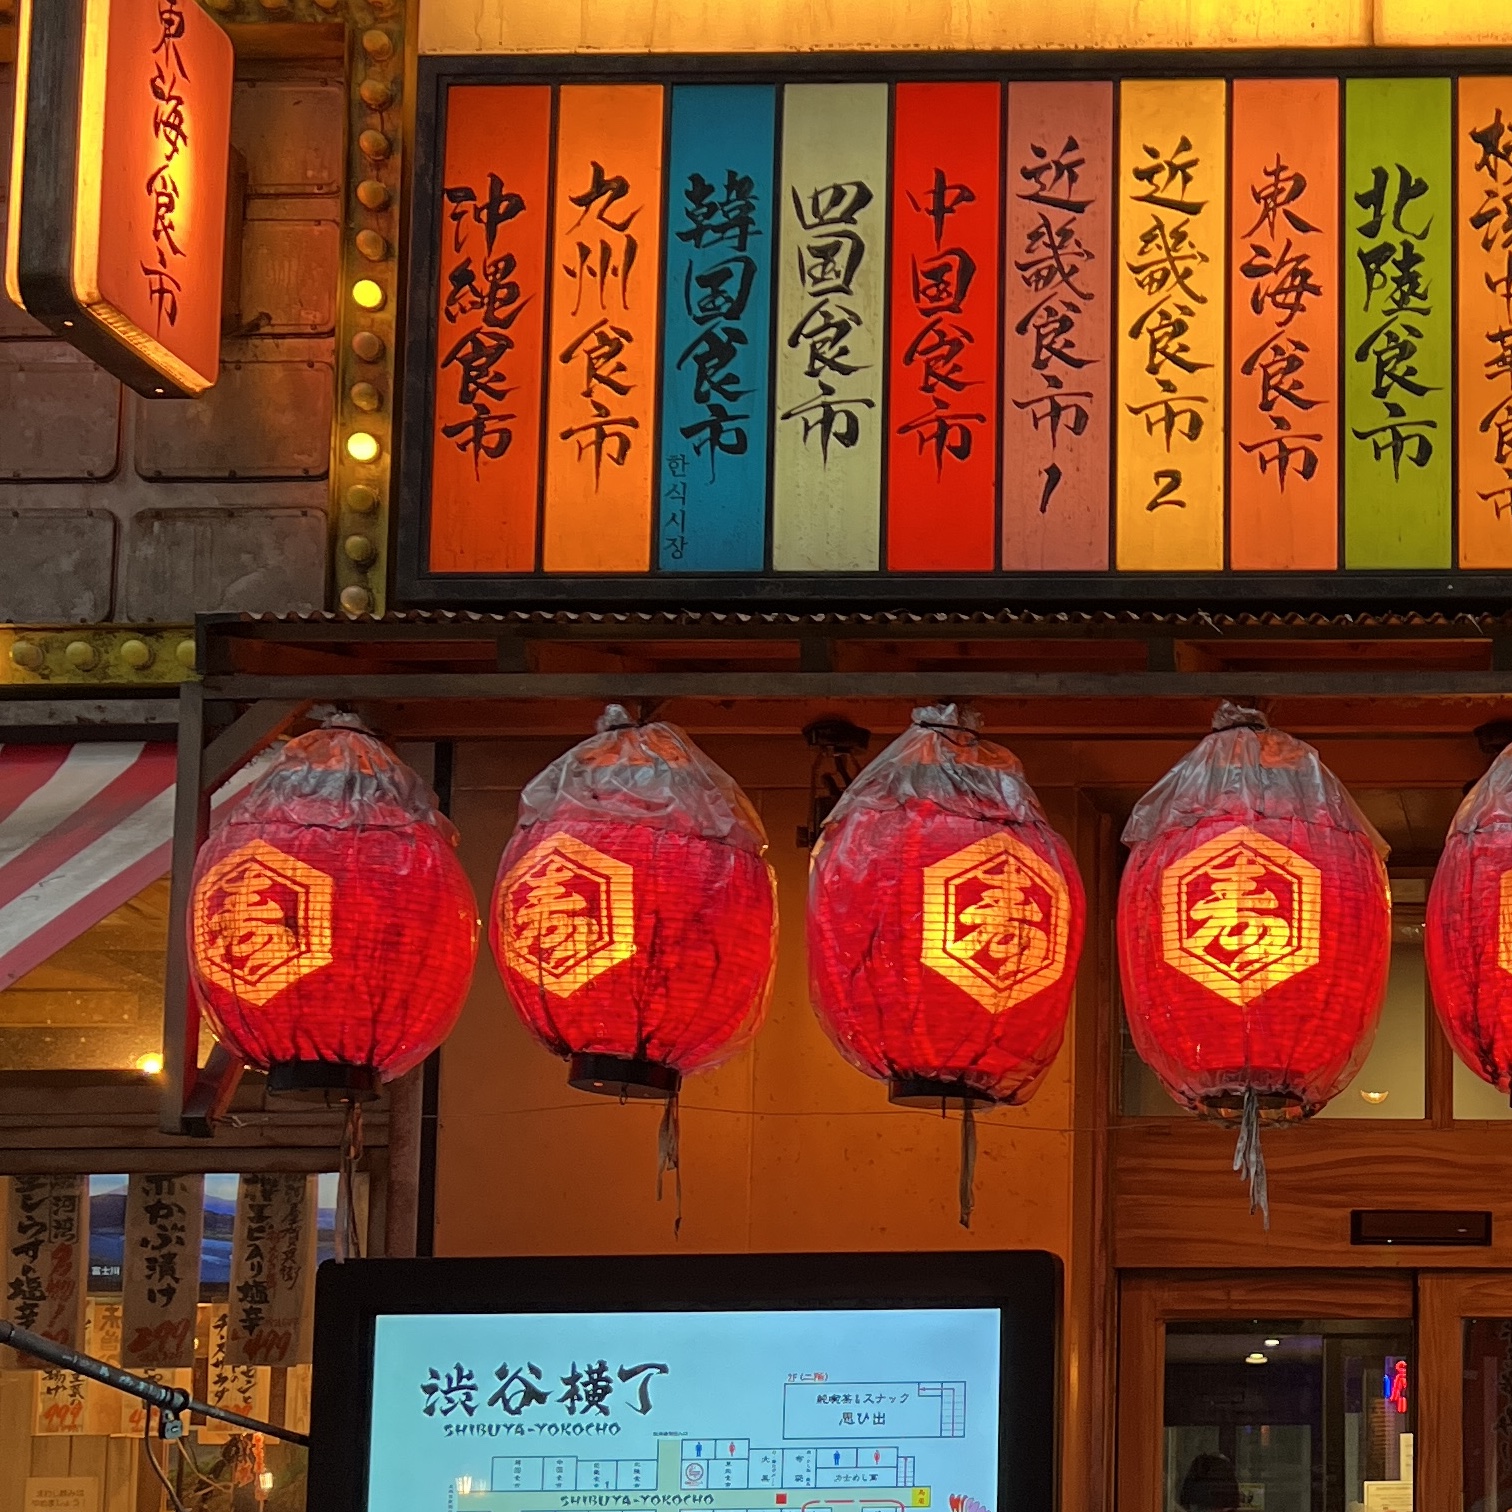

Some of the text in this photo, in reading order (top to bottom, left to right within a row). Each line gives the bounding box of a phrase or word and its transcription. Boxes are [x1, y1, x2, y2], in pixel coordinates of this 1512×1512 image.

[141, 0, 190, 337] 東海食市
[441, 173, 536, 481] 沖縄食市
[560, 161, 645, 493] 九州食市
[675, 170, 763, 484] 韓国食市
[781, 180, 876, 472] 四国食市
[897, 167, 987, 484] 中国食市
[1239, 153, 1330, 493] 東海食市
[1351, 163, 1445, 482] 北陸食市
[664, 454, 689, 559] 한식시장
[92, 1266, 120, 1276] 富士川
[420, 1360, 669, 1417] 渋谷横丁
[839, 1412, 886, 1425] 思ひ出
[444, 1422, 621, 1437] SHIBUYA-YOKOCHO
[560, 1493, 714, 1507] SHIBUYA-YOKOCHO
